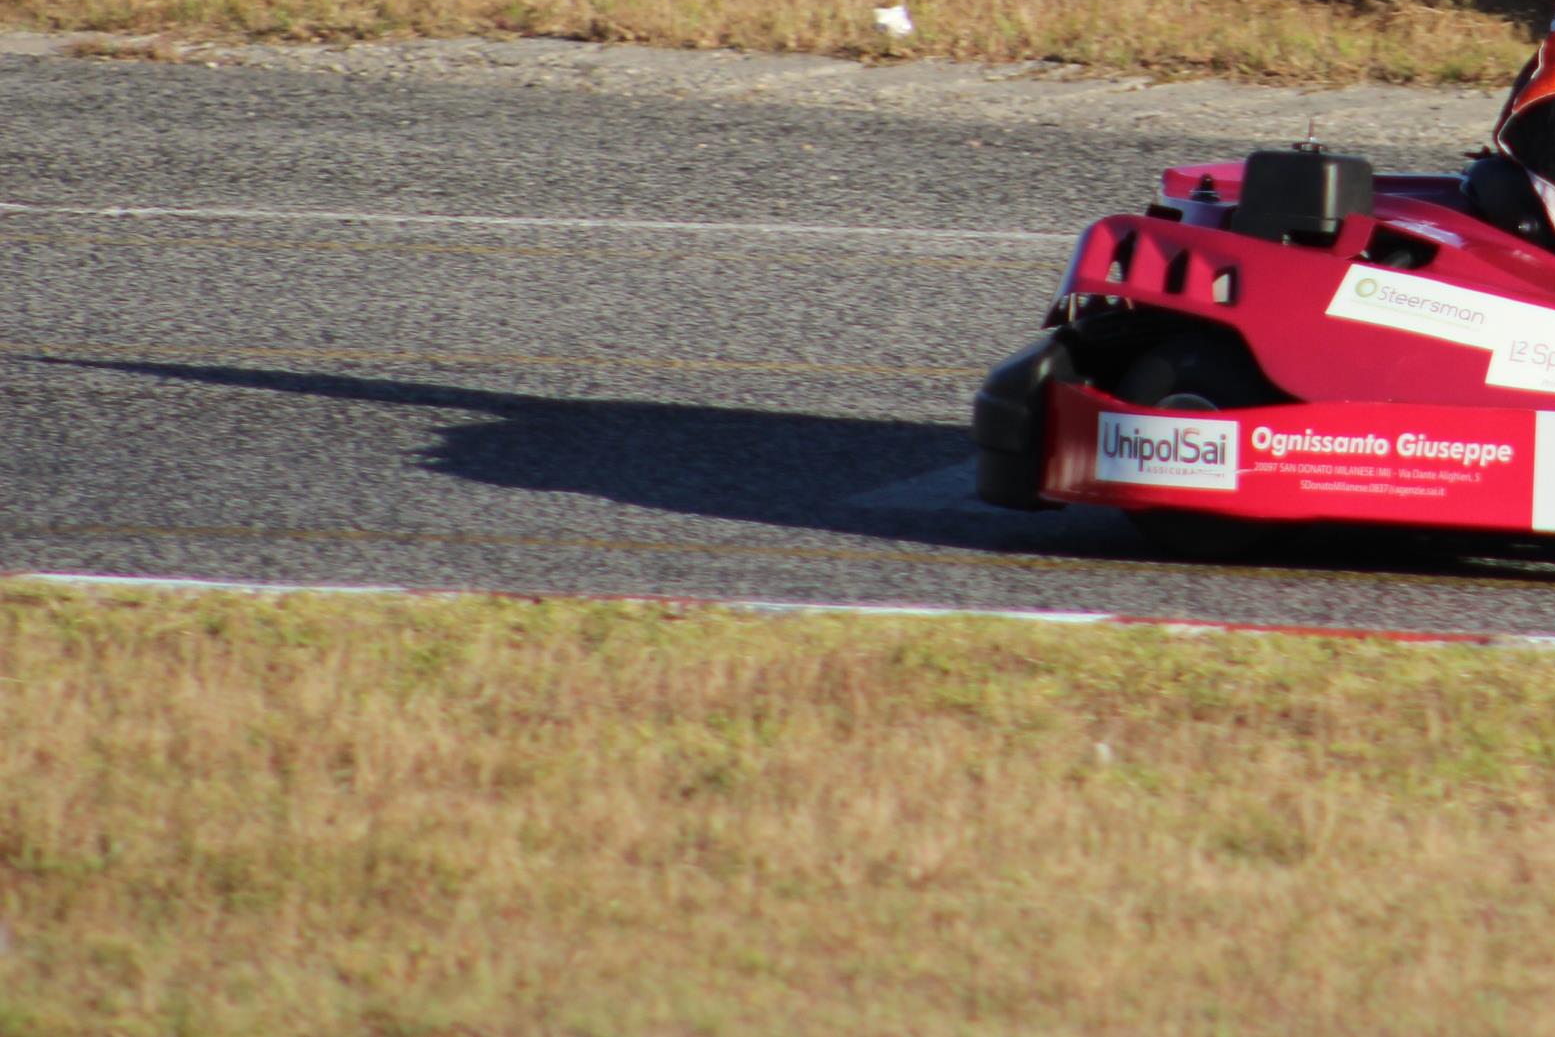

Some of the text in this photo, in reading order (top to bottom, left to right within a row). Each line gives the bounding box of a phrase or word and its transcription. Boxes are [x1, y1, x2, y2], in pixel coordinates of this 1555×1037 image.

[1378, 285, 1486, 325] Steersman
[1103, 422, 1227, 472] UnipolSai
[1251, 426, 1514, 467] Ognissanto Giuseppe
[1279, 462, 1297, 473] SAN
[1298, 463, 1333, 475] DONATO
[1334, 465, 1375, 477] MILANESE
[1412, 468, 1437, 480] Dante
